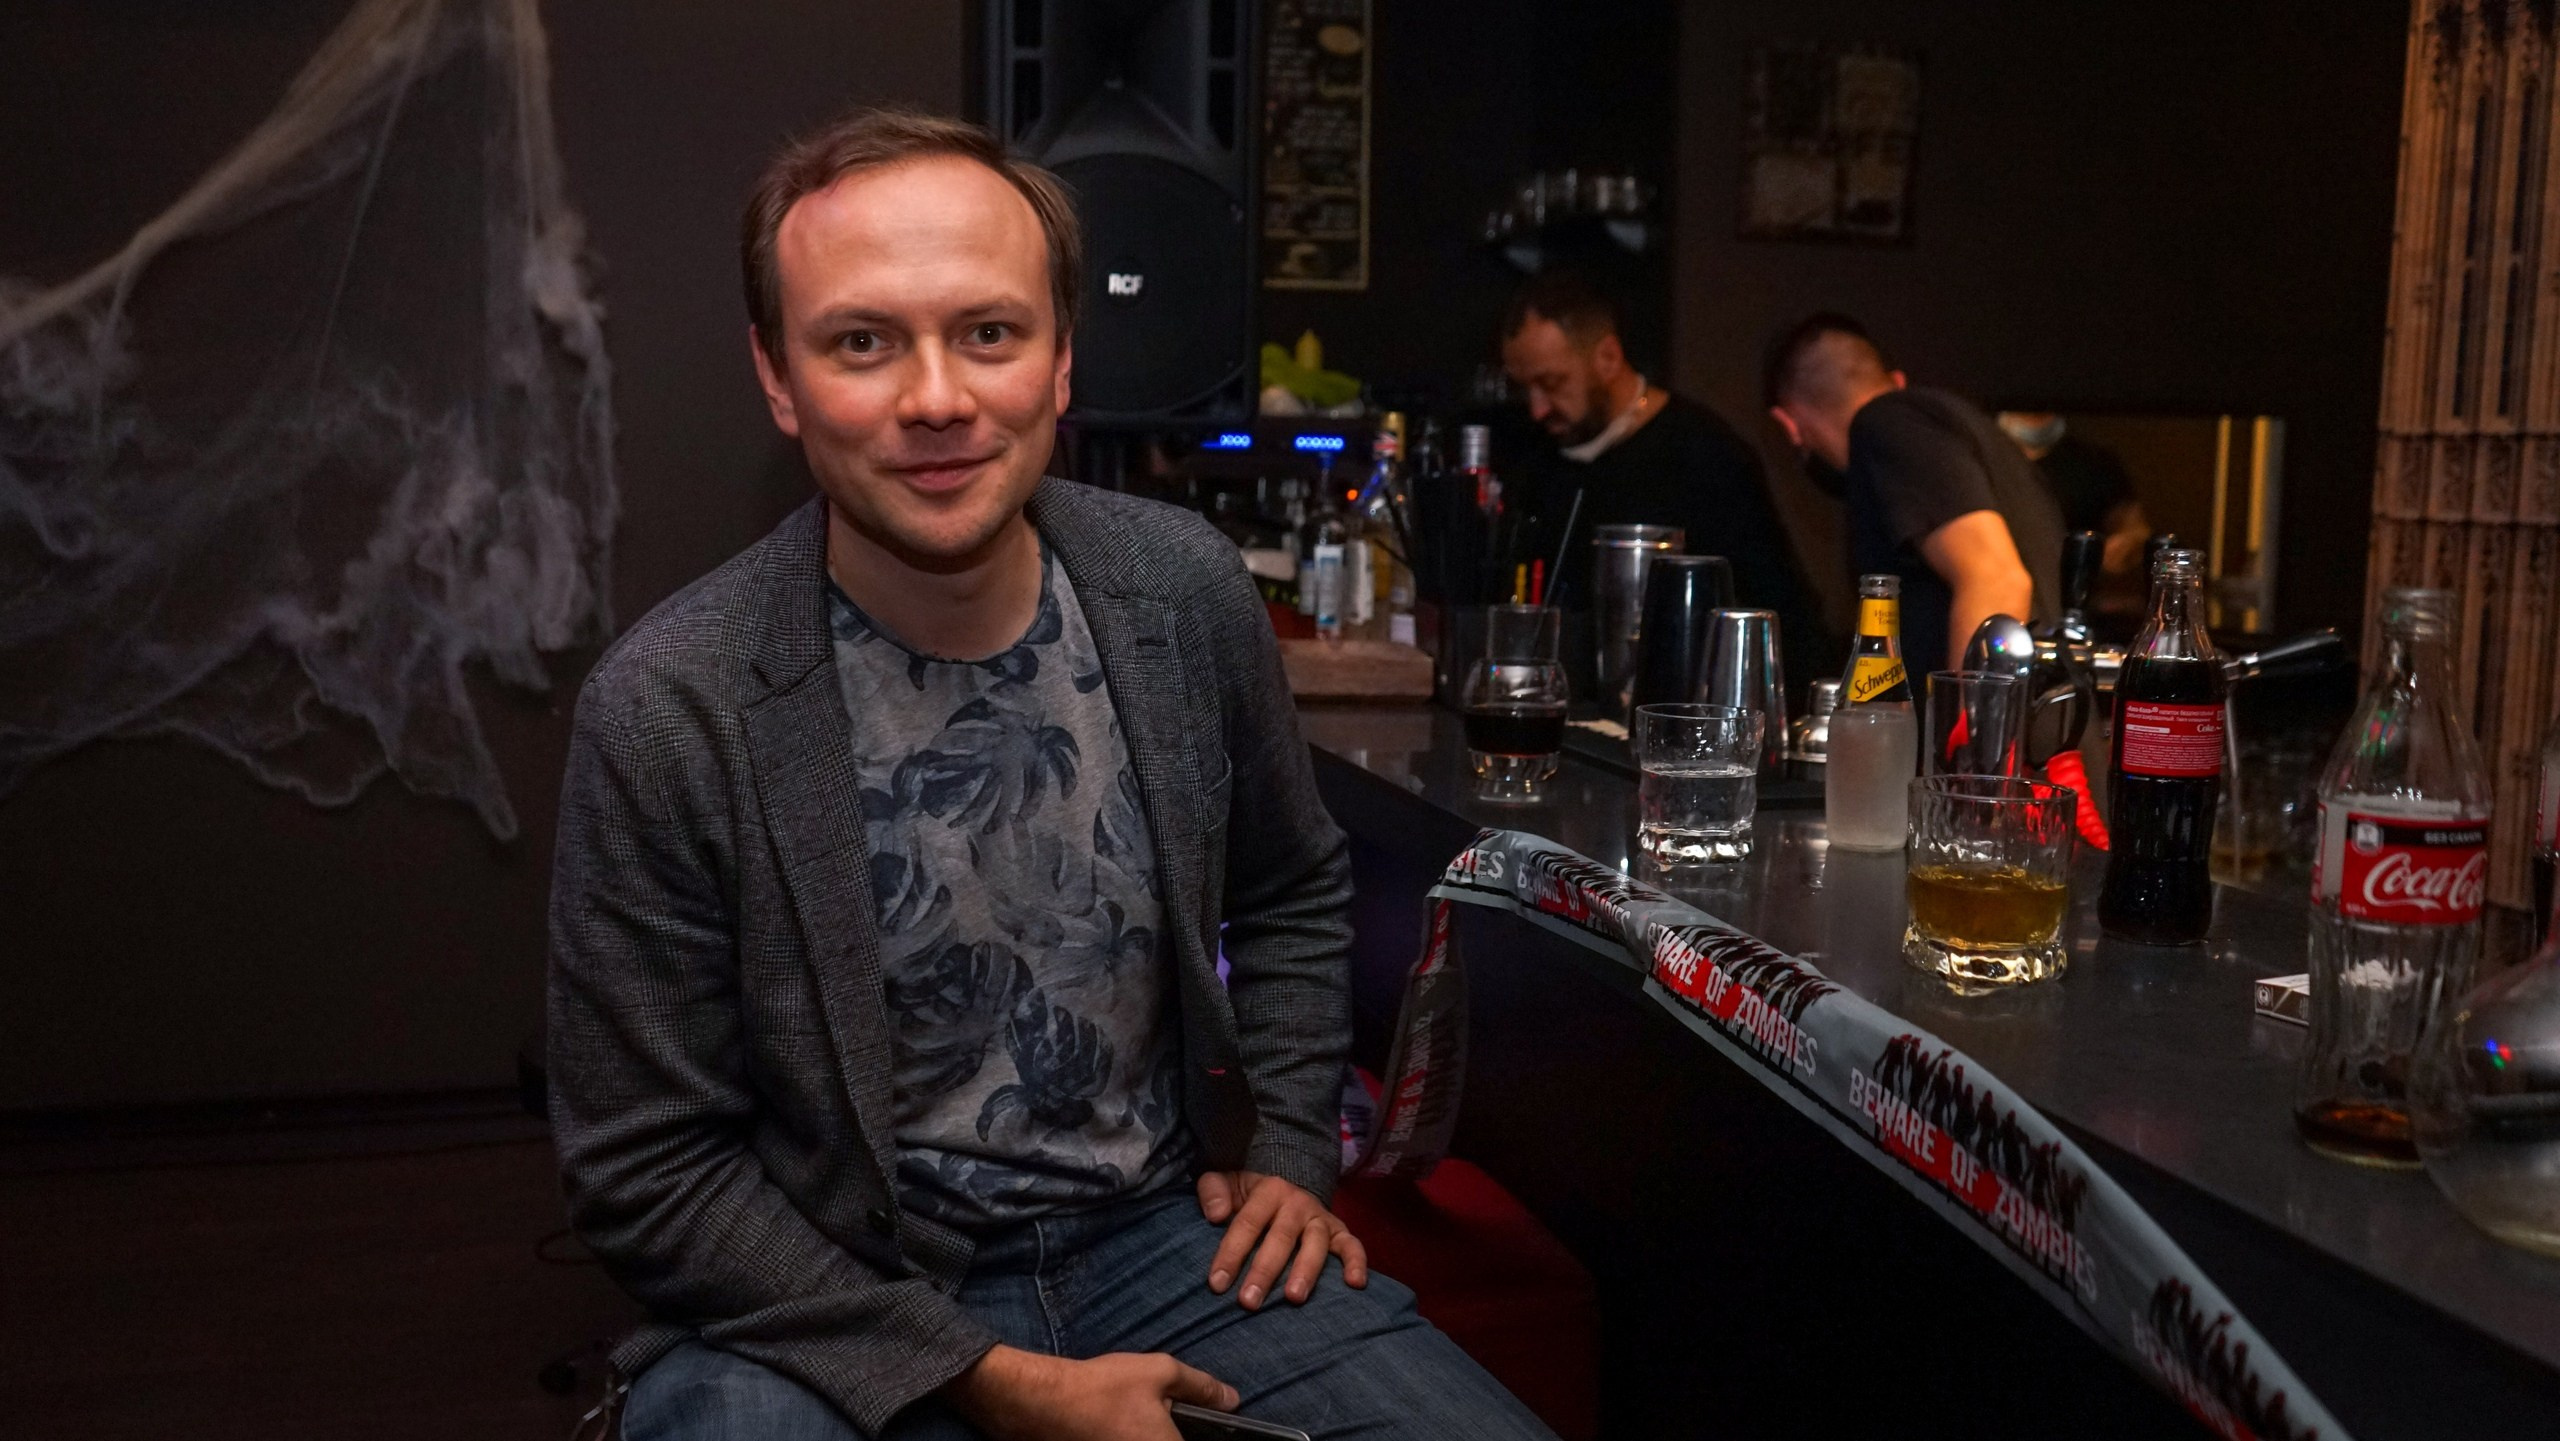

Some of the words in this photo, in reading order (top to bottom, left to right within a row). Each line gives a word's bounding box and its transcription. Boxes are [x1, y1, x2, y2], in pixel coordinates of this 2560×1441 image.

[1109, 273, 1143, 295] RCF
[1647, 922, 1705, 986] BEWARE
[1705, 965, 1733, 1007] OF
[1734, 985, 1818, 1078] ZOMBIES
[1850, 1066, 1938, 1164] BEWARE
[1950, 1146, 1983, 1195] OF
[1993, 1174, 2098, 1304] ZOMBIES
